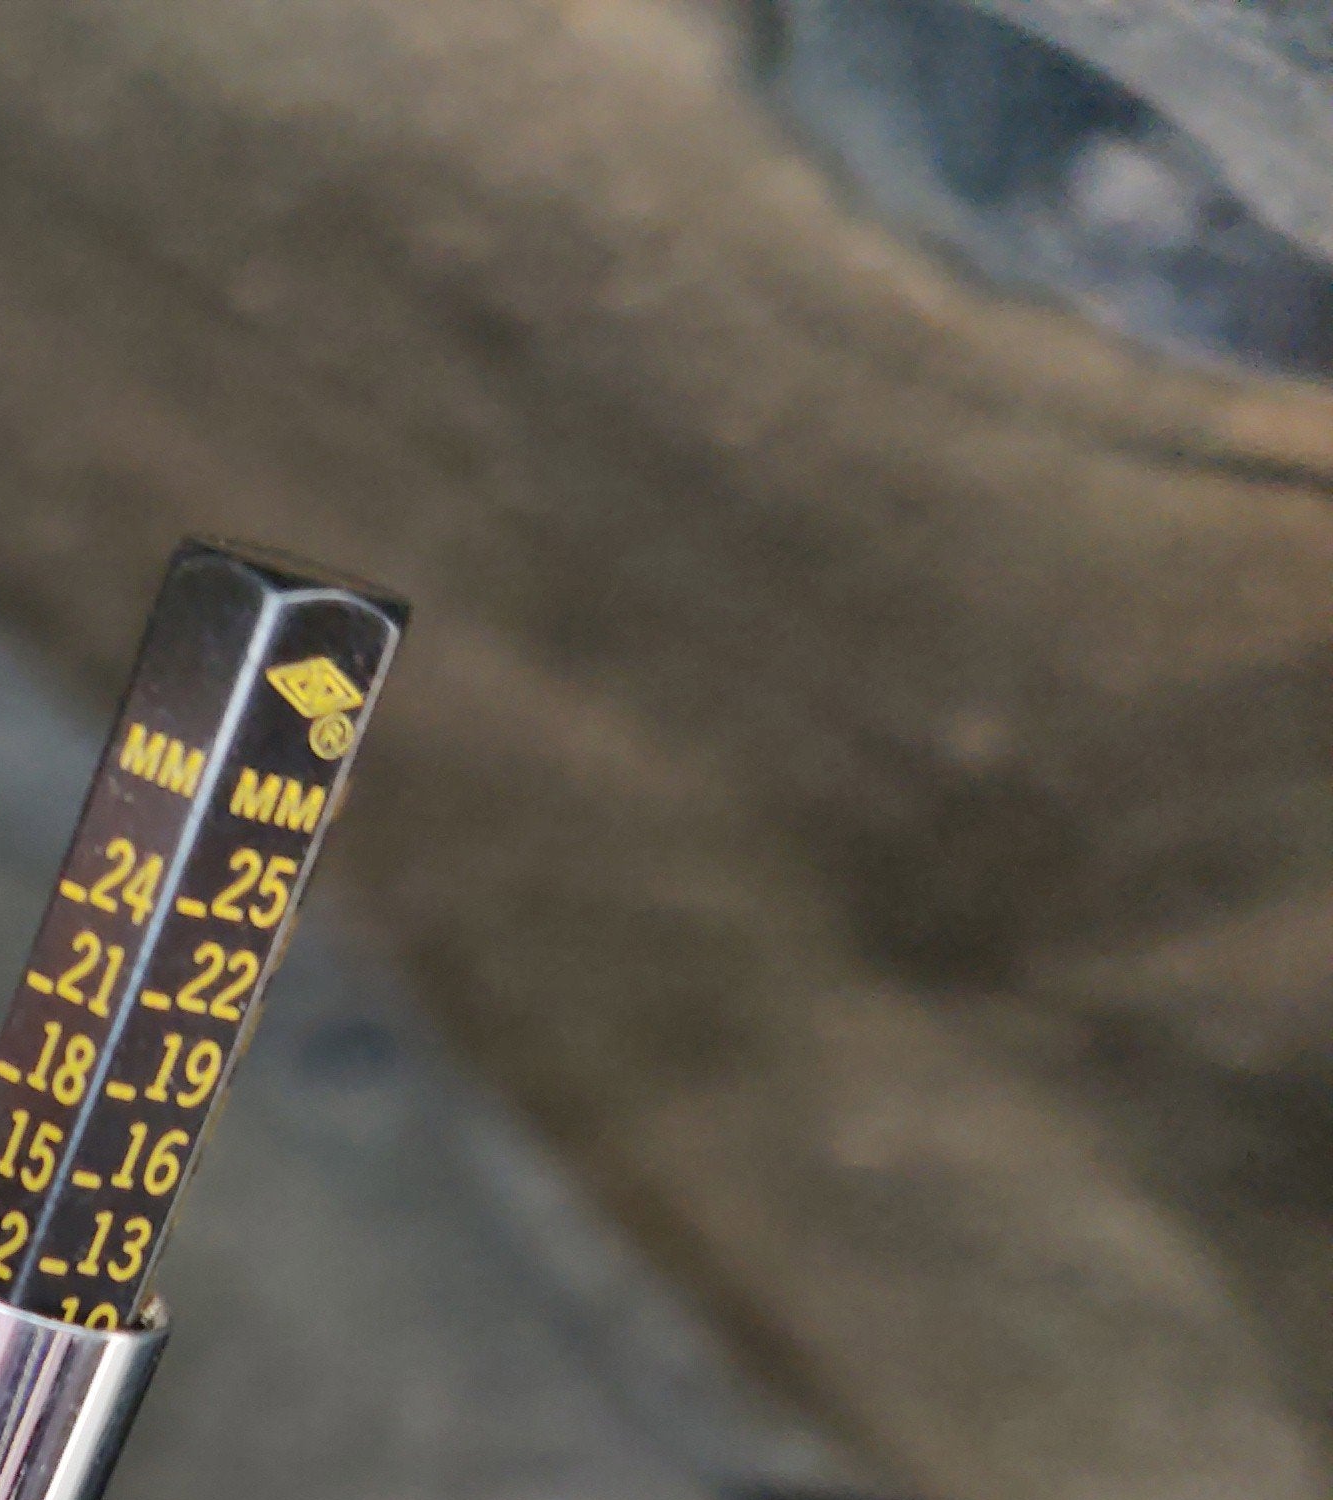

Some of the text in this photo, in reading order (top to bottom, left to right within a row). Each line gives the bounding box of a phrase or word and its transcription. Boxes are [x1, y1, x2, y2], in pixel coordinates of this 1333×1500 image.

[119, 722, 205, 798] MM
[229, 767, 326, 833] MM
[85, 838, 163, 924] 24
[210, 848, 298, 930] 25
[54, 931, 124, 1018] 21
[176, 941, 260, 1022] 22
[26, 1020, 96, 1107] 18
[144, 1033, 222, 1109] 19
[110, 1122, 190, 1197] 16
[76, 1210, 153, 1283] 13
